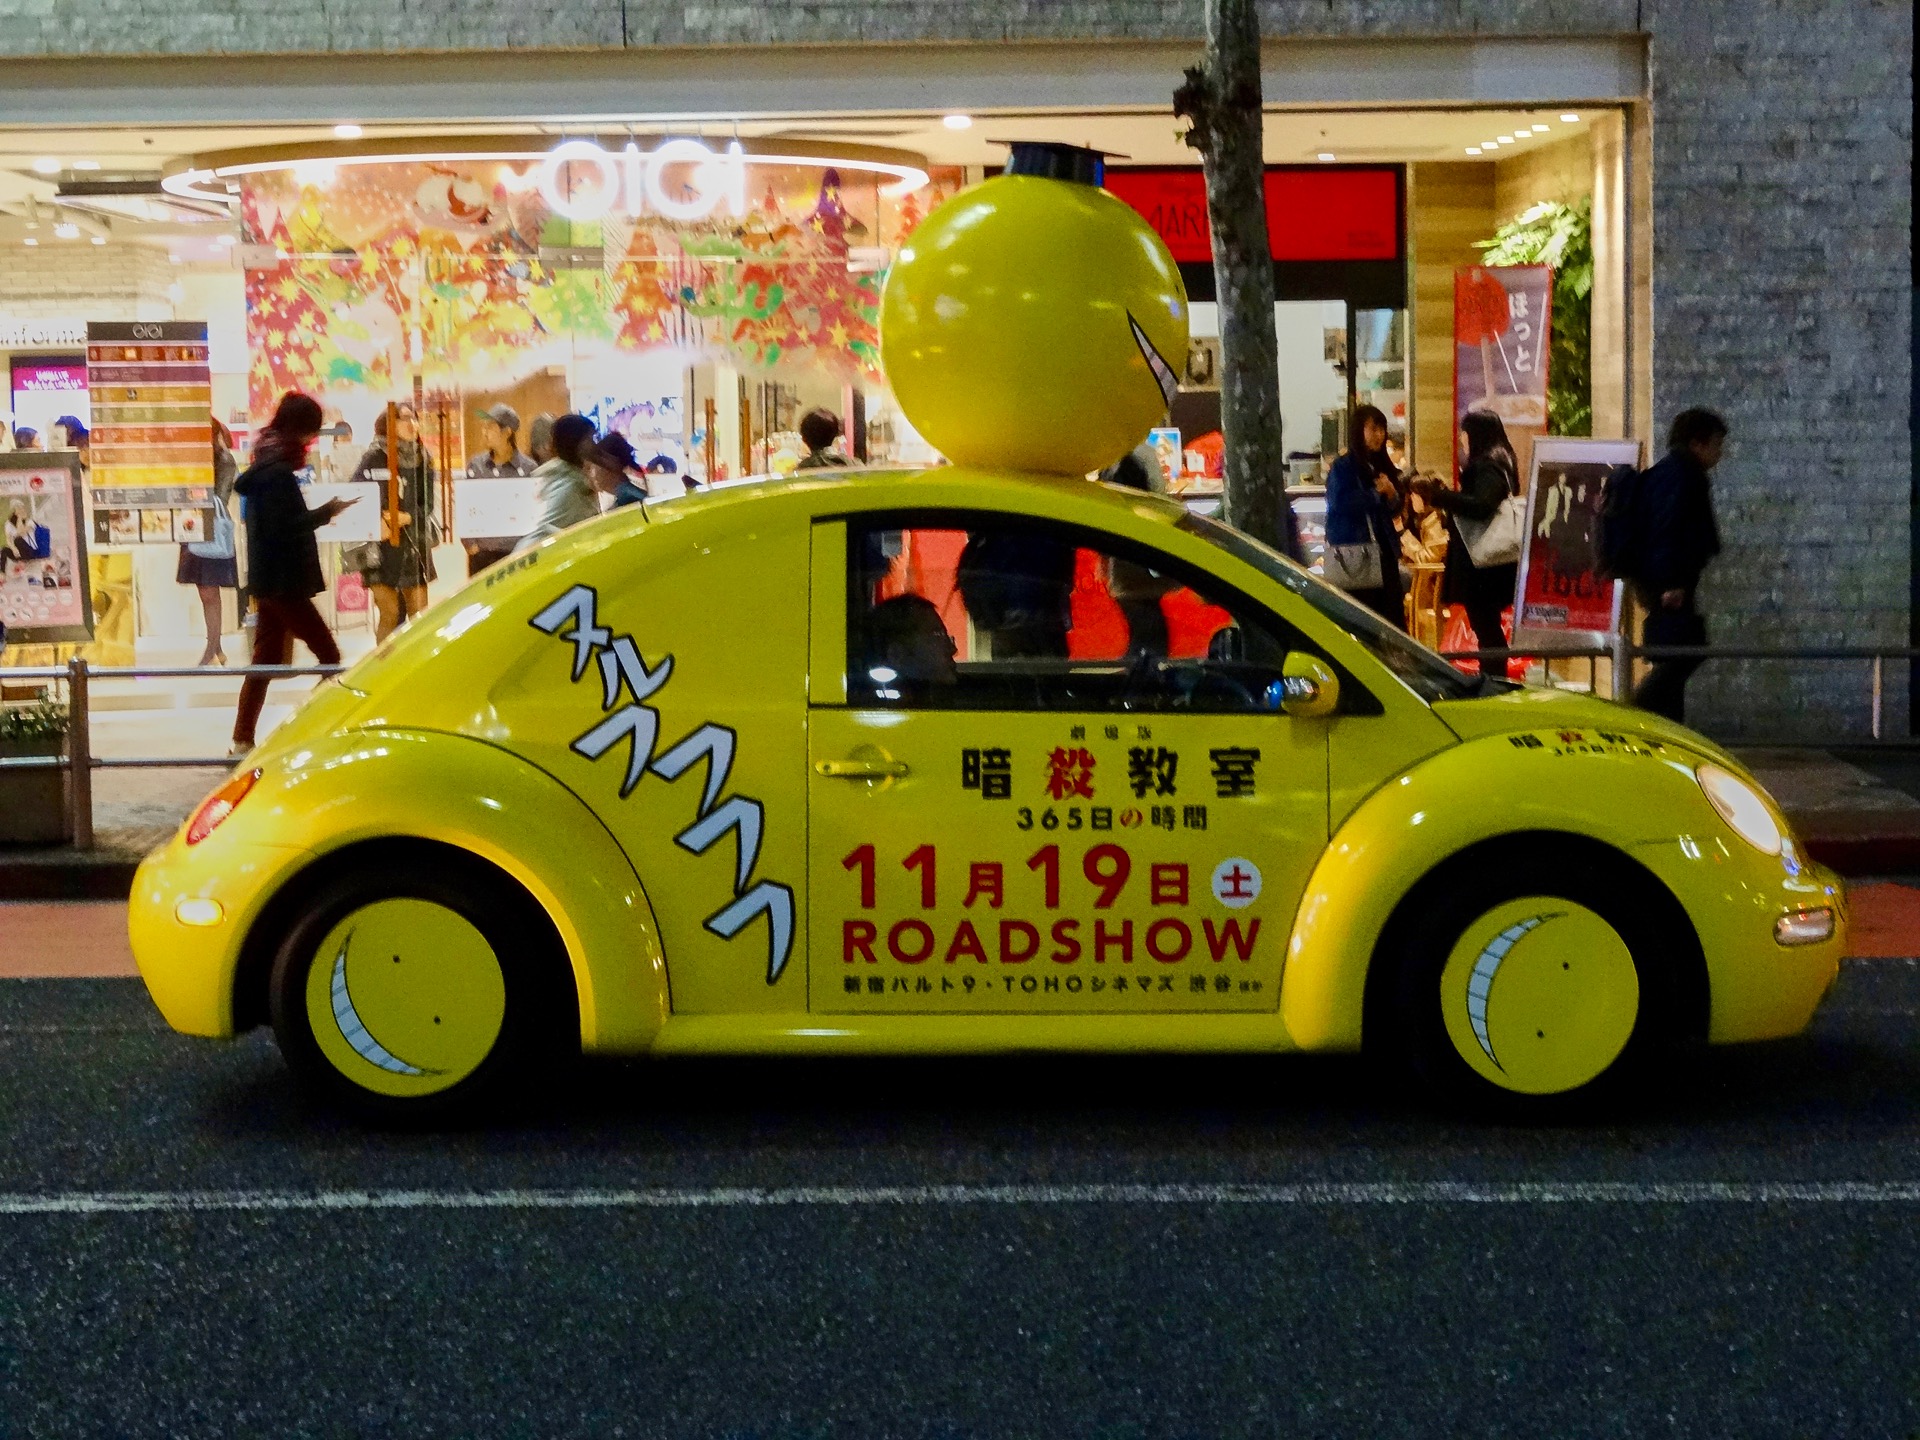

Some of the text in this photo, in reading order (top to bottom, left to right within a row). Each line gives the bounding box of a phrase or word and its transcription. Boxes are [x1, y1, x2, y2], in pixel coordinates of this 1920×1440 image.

[961, 746, 1262, 801] 暗殺教室
[1016, 805, 1208, 831] 365日の時間
[842, 843, 1189, 909] 11月19日
[842, 918, 1262, 964] ROADSHOW
